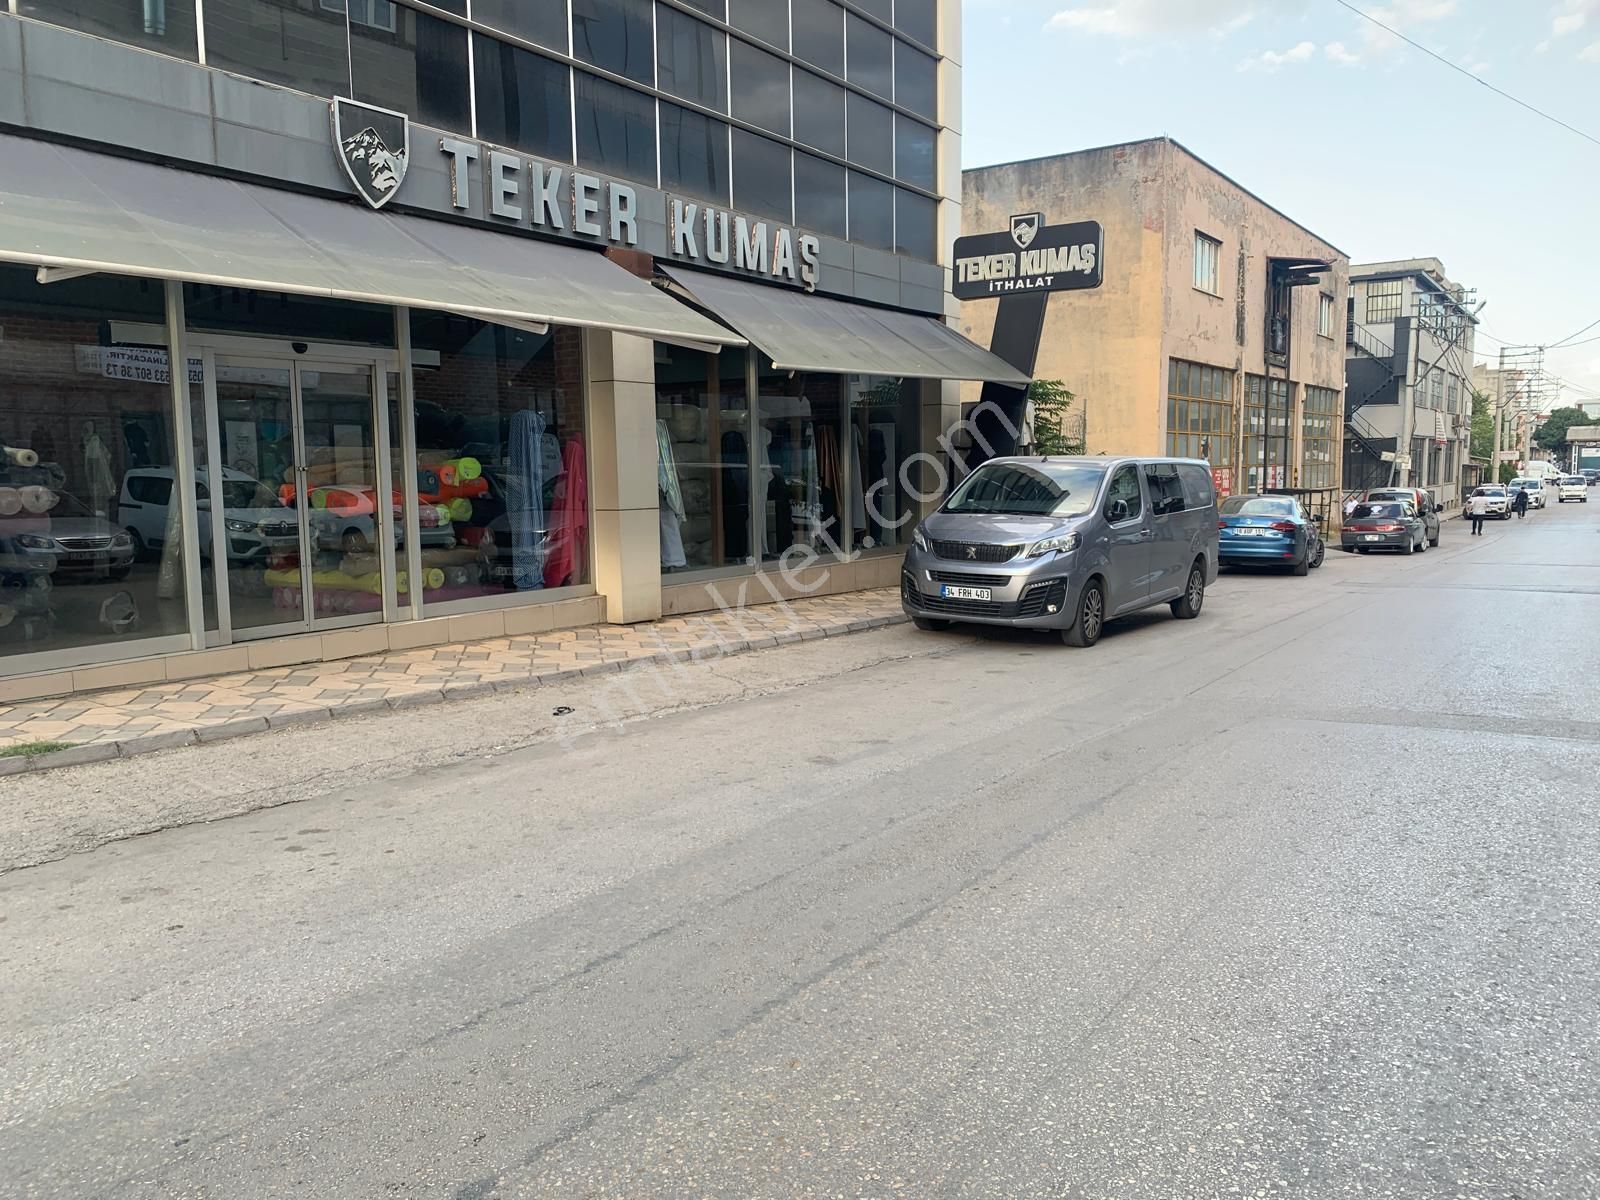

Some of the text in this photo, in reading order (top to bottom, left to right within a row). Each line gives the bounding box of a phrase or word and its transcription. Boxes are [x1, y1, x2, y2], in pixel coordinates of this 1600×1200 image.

[440, 136, 820, 293] TEKER KUMAŞ
[955, 243, 1096, 284] TEKER KUMAŞ
[989, 275, 1054, 292] İTHALAT
[945, 587, 990, 599] 34 FRH 403
